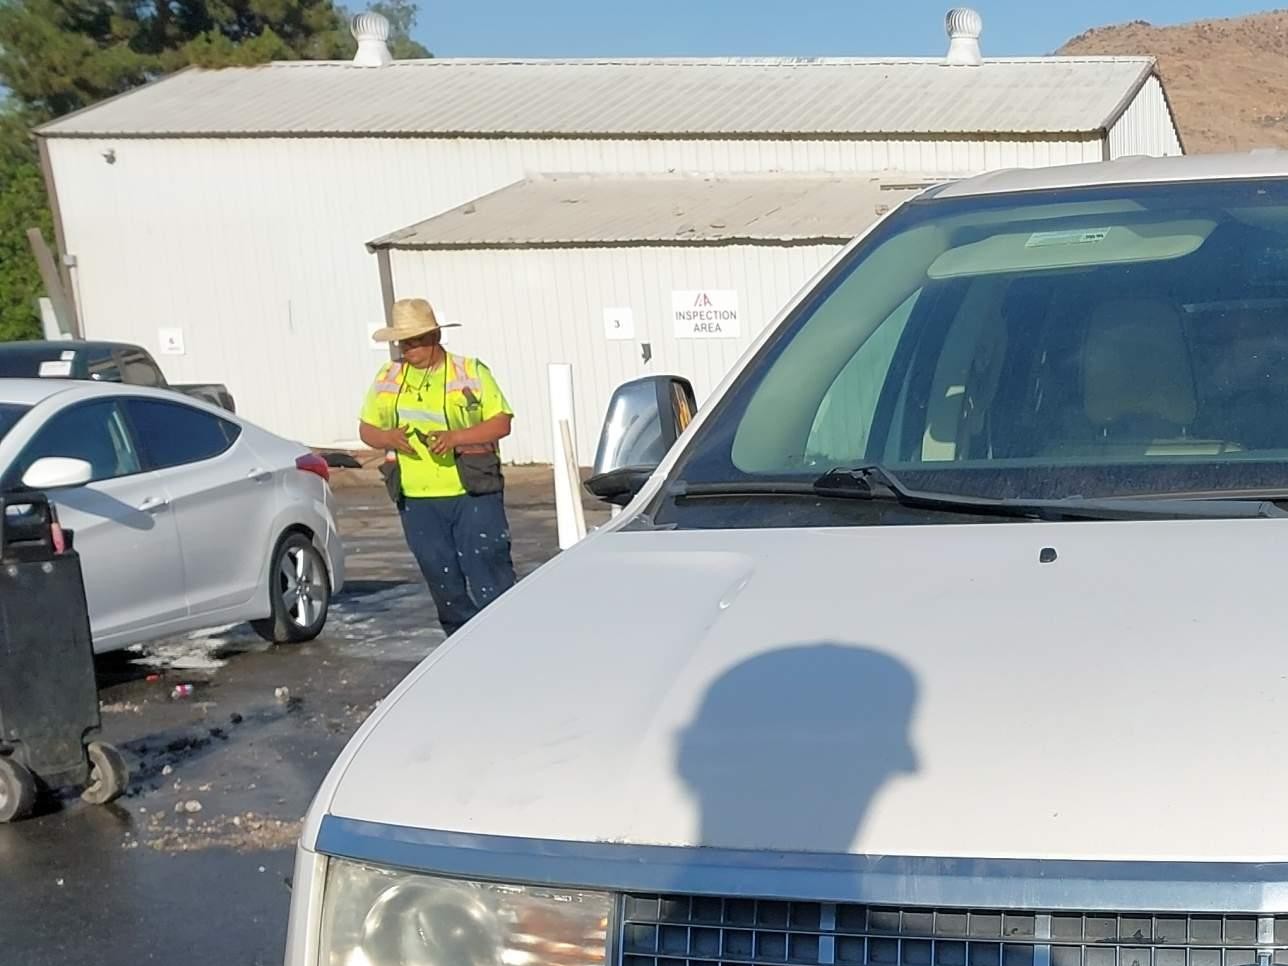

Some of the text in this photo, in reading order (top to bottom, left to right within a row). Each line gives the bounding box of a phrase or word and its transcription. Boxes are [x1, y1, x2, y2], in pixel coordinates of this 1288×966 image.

[675, 310, 737, 321] INSPECTION
[613, 319, 621, 329] 3
[693, 323, 722, 333] AREA
